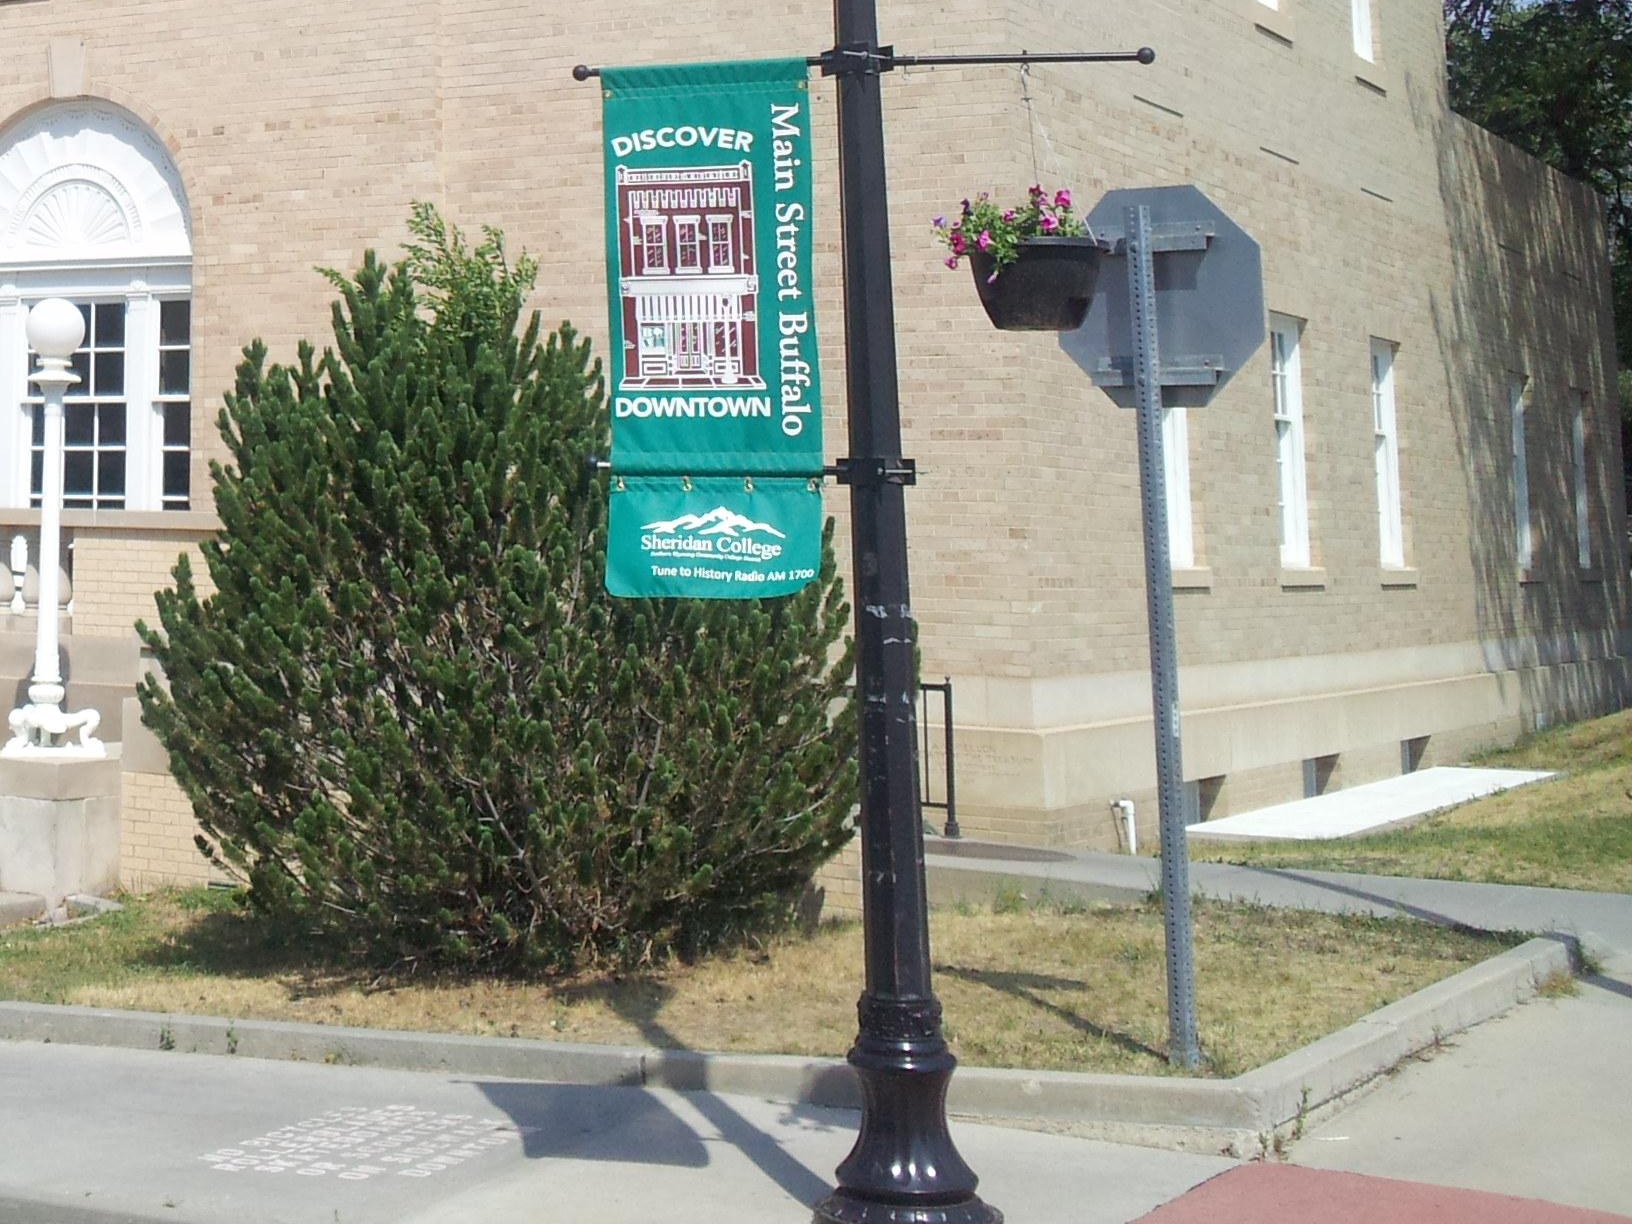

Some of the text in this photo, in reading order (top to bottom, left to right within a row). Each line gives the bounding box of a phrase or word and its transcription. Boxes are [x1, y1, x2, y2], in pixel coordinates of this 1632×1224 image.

[611, 126, 754, 157] DISCOVER
[771, 103, 811, 436] Main Street Buffalo
[615, 397, 771, 417] DOWNTOWN
[641, 535, 712, 552] Sheridan
[717, 537, 782, 559] College
[651, 565, 815, 583] Tune to History Radio AM 1700
[198, 1147, 245, 1162] NO
